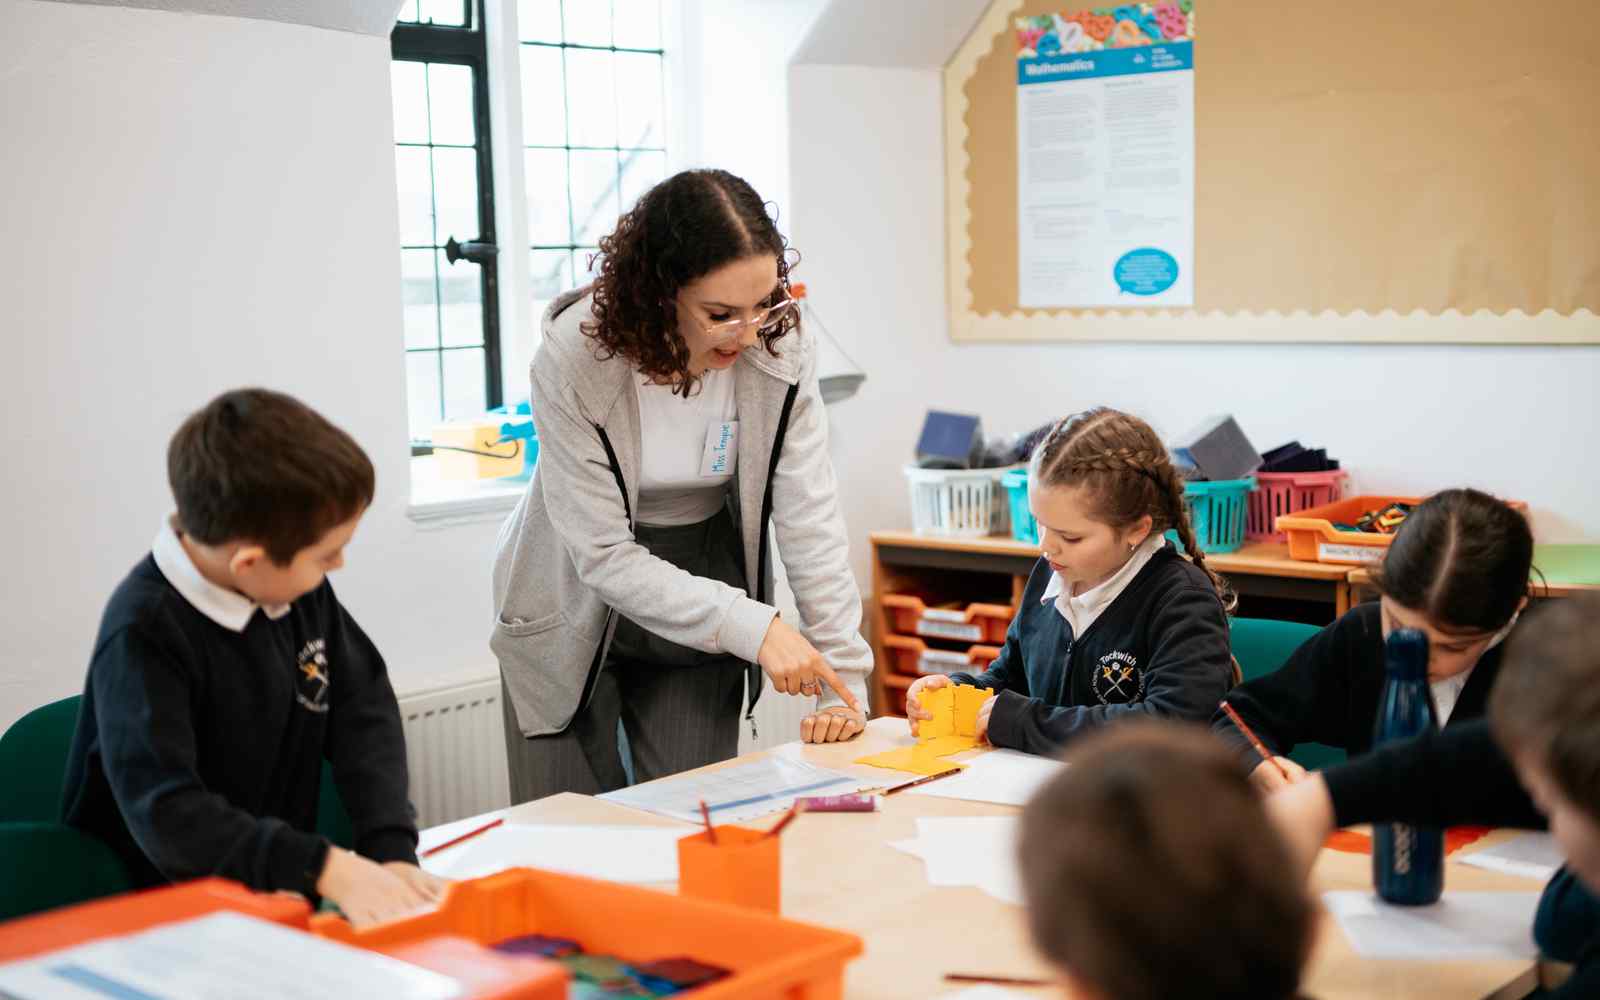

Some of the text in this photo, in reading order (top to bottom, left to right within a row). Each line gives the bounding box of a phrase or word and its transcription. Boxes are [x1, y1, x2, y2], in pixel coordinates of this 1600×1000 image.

[1025, 60, 1095, 76] Mathematics
[711, 455, 725, 472] Miss
[1099, 650, 1137, 667] Tockwith
